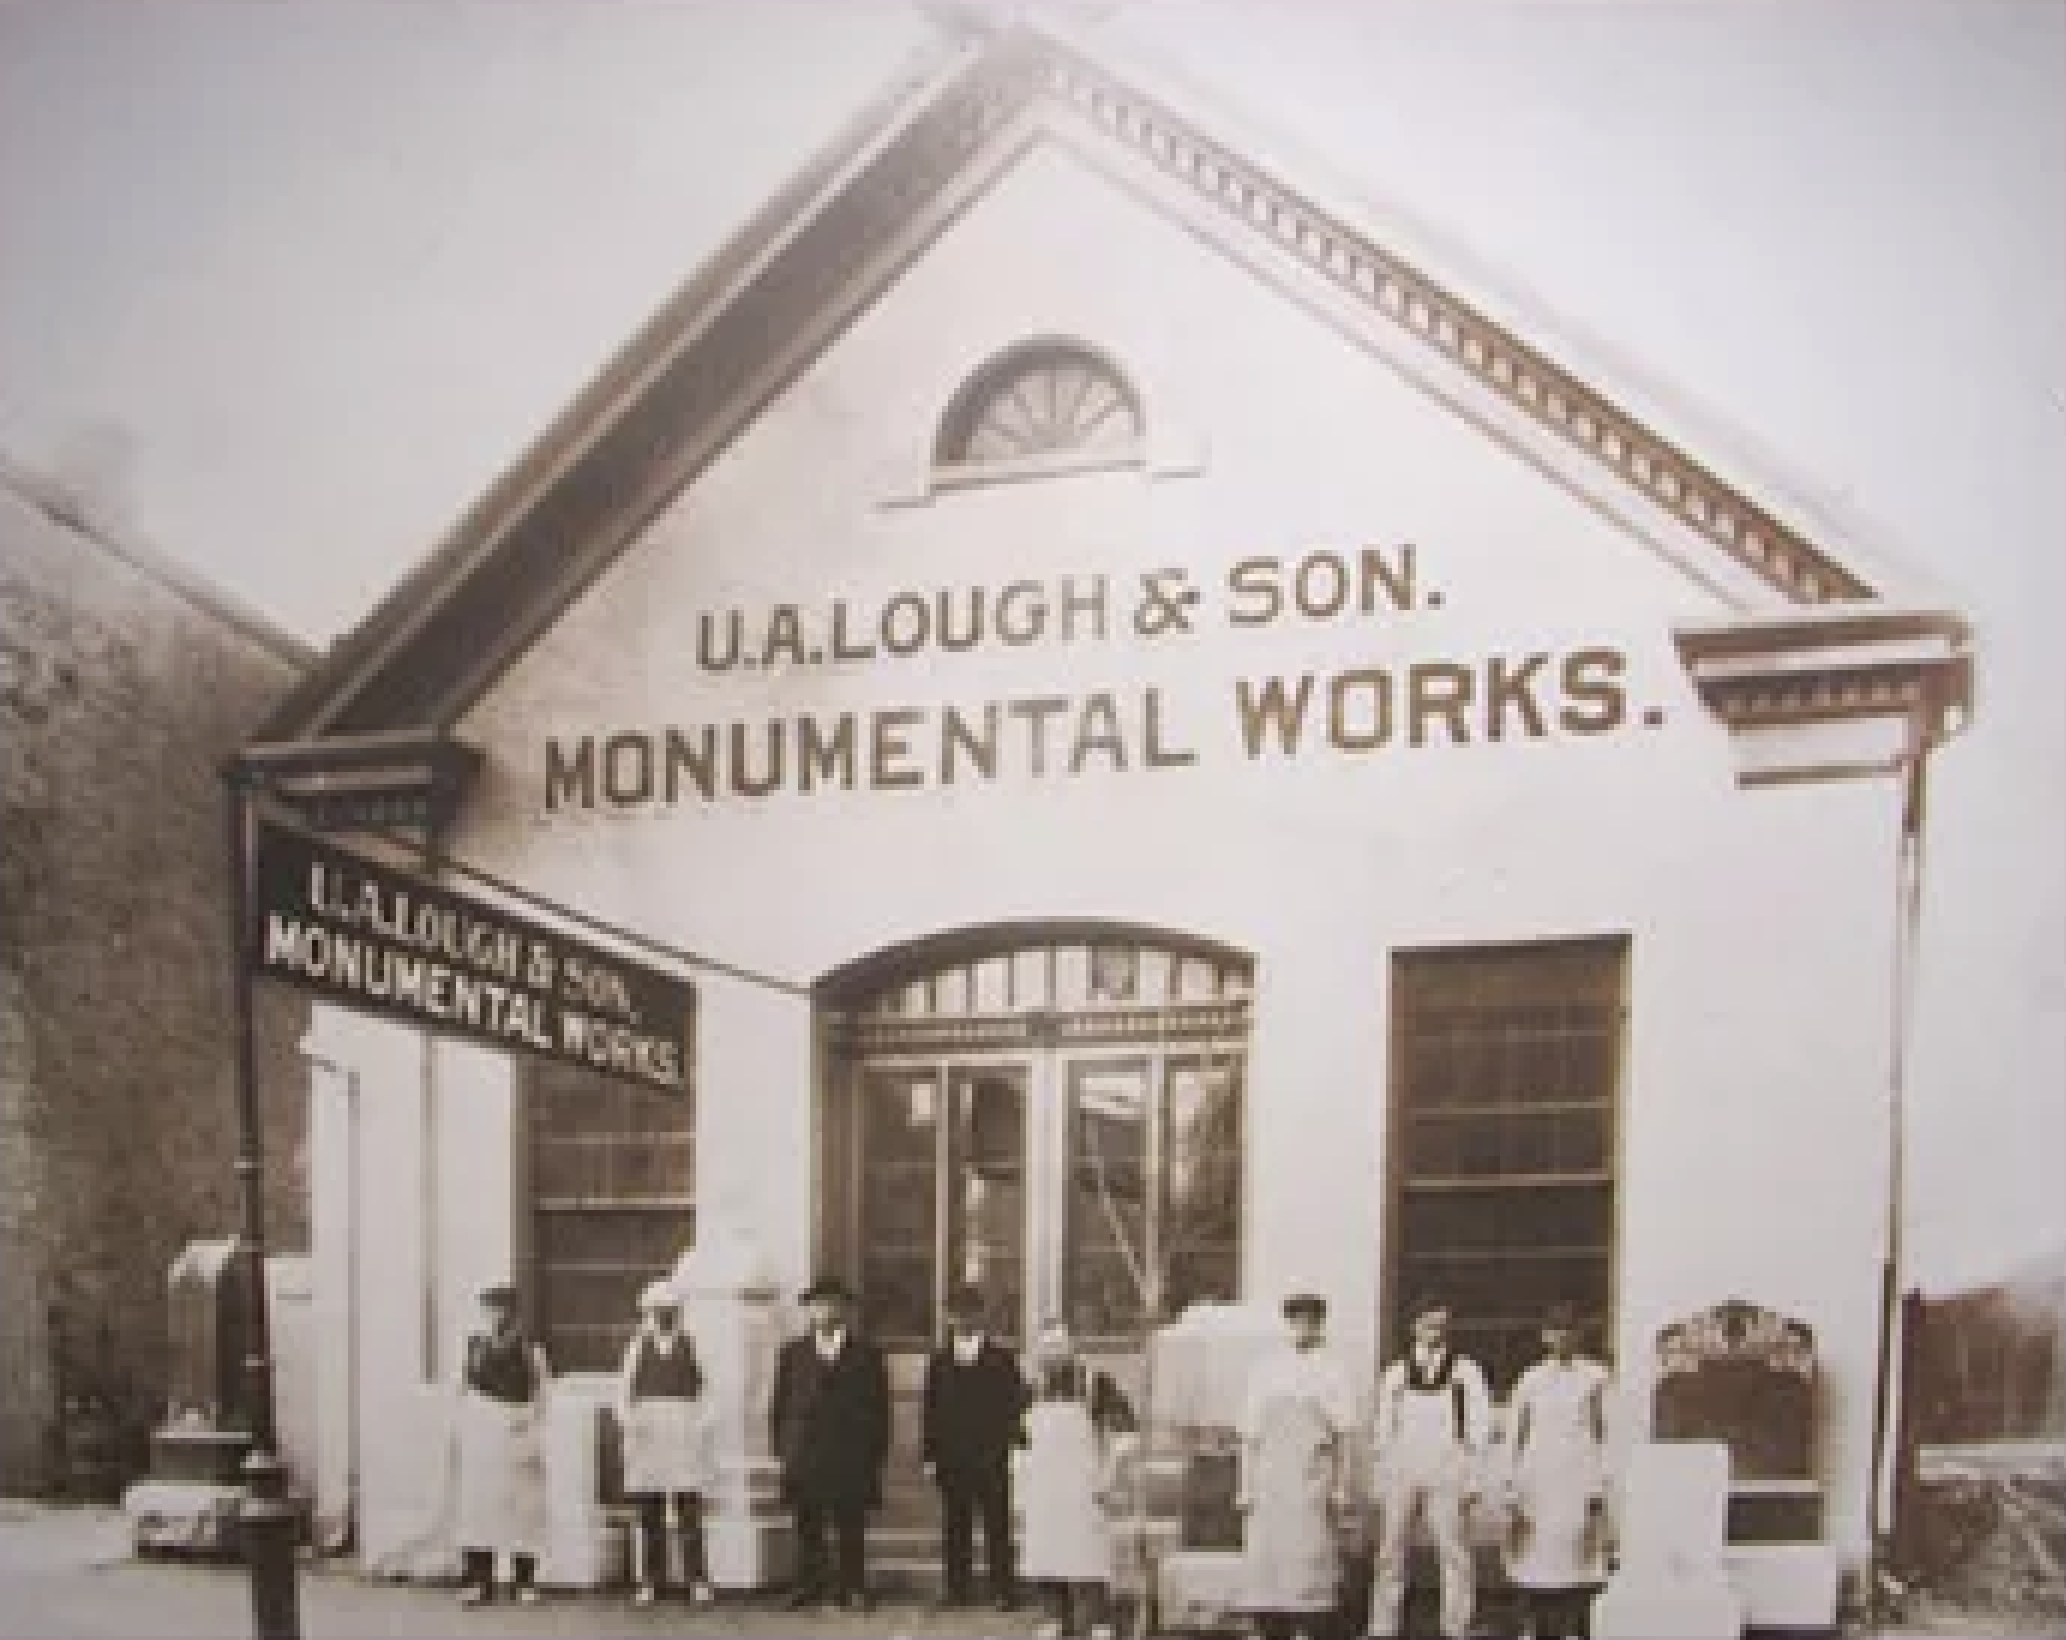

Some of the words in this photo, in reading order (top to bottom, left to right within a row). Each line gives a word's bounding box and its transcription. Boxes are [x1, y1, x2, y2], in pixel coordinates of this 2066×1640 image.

[698, 573, 1107, 671] U.A.LOUGH
[1133, 567, 1201, 637] &
[1228, 543, 1447, 628] SON.
[545, 688, 1195, 808] MONUMENTAL
[1235, 646, 1663, 760] WORKS.
[265, 915, 553, 1048] MONUMENTAL
[526, 944, 553, 988] &
